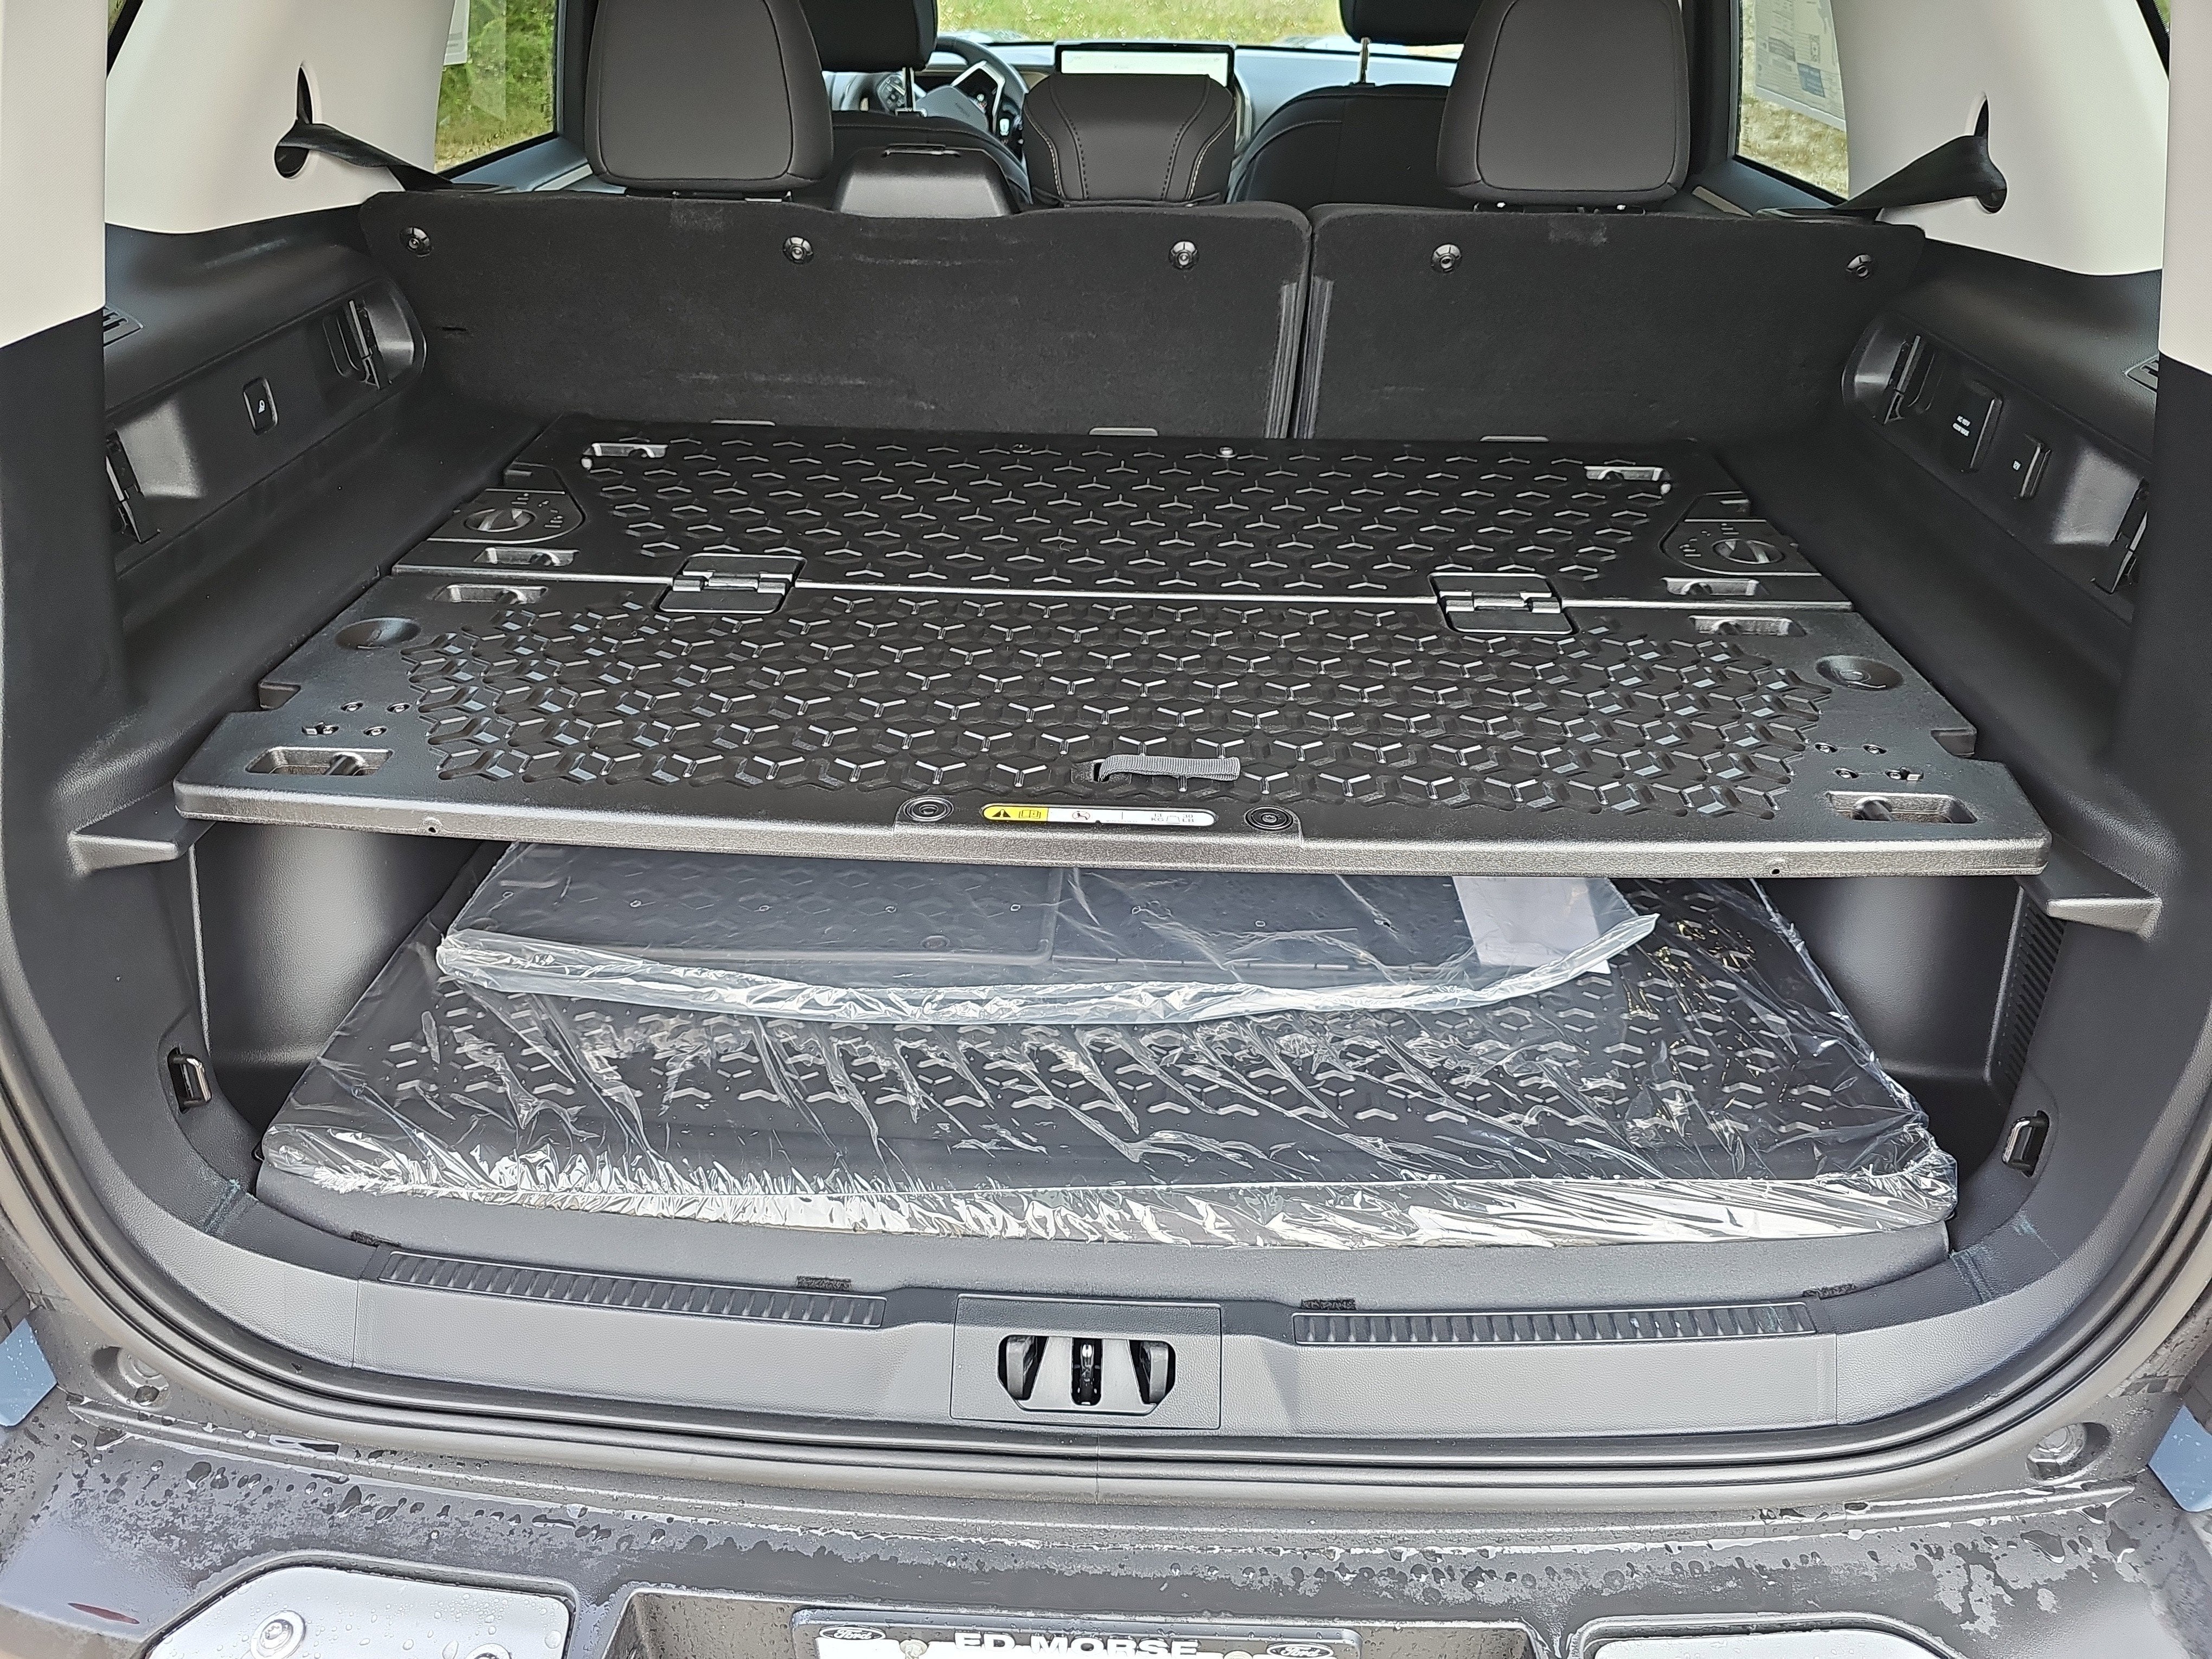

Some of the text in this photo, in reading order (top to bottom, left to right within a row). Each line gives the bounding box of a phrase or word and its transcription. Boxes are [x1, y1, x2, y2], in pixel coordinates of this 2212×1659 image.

[833, 1628, 873, 1641] Ford
[954, 1632, 1199, 1657] ED MORSE
[1279, 1645, 1321, 1657] Ford
